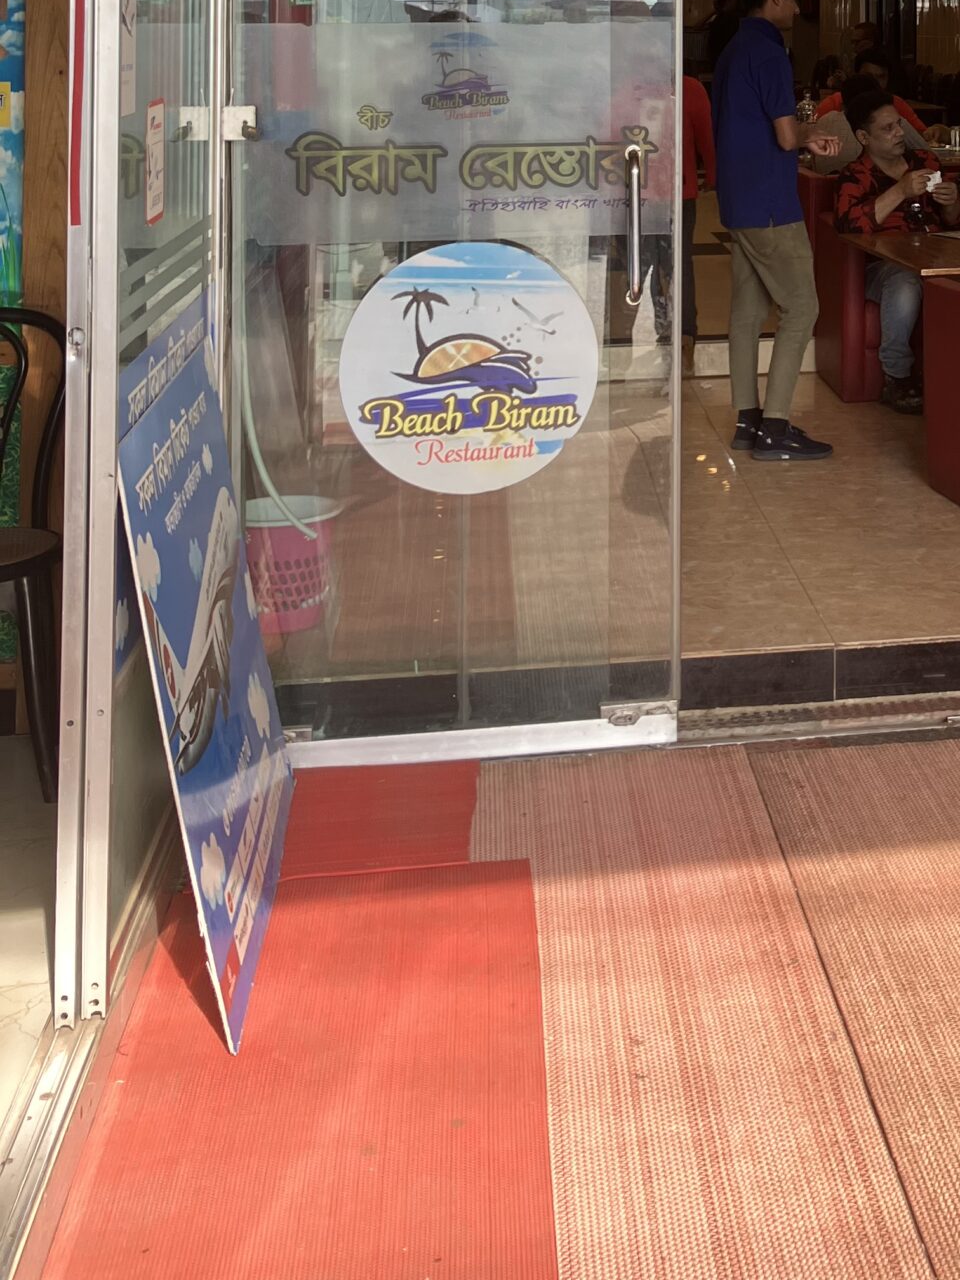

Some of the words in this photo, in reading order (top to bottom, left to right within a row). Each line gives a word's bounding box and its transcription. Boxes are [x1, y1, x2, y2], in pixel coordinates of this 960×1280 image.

[466, 91, 510, 107] Biram
[357, 105, 393, 131] বীচ
[286, 131, 448, 197] বিরাম
[363, 393, 463, 439] Beach
[471, 392, 581, 433] Biram
[415, 438, 535, 467] Restaurant
